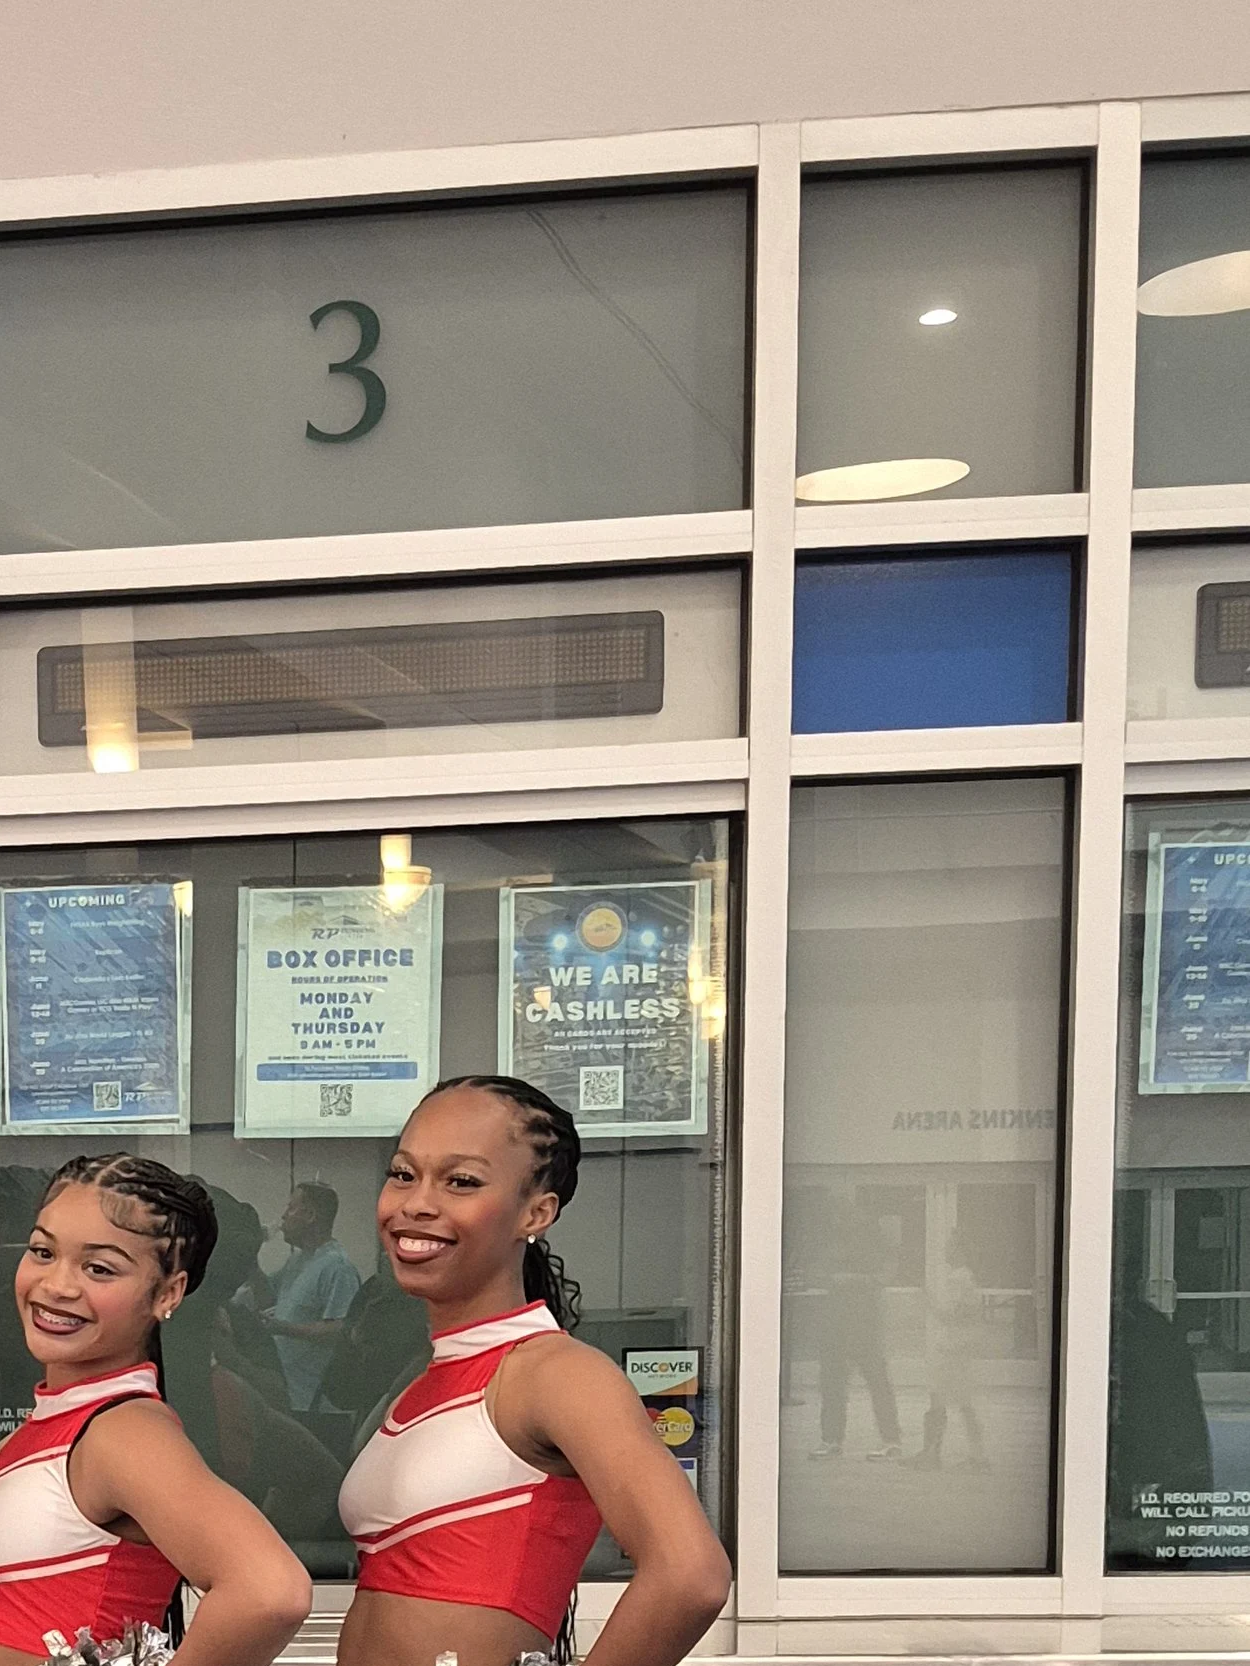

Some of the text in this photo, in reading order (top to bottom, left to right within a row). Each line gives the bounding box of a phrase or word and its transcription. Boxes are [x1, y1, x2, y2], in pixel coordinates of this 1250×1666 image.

[306, 300, 387, 444] 3
[48, 894, 126, 908] UPCOMING
[267, 948, 414, 968] BOX OFFICE
[291, 976, 321, 984] HOURS
[337, 975, 388, 984] OPERATION
[550, 963, 658, 986] WE ARE
[300, 992, 373, 1005] MONDAY
[319, 1007, 354, 1019] AND
[526, 998, 681, 1022] CASHLESS
[291, 1022, 386, 1034] THURSDAY
[312, 1040, 332, 1049] AM
[344, 1039, 353, 1049] 5
[357, 1039, 376, 1048] PM
[631, 1361, 693, 1373] DISCOVER
[653, 1420, 693, 1434] erCard
[1141, 1491, 1250, 1504] I.D. REQUIRED FO
[1141, 1505, 1250, 1518] WILL CALL PICKU
[1166, 1524, 1249, 1537] NO REFUNDS
[1156, 1545, 1250, 1558] NO EXCHANGE
